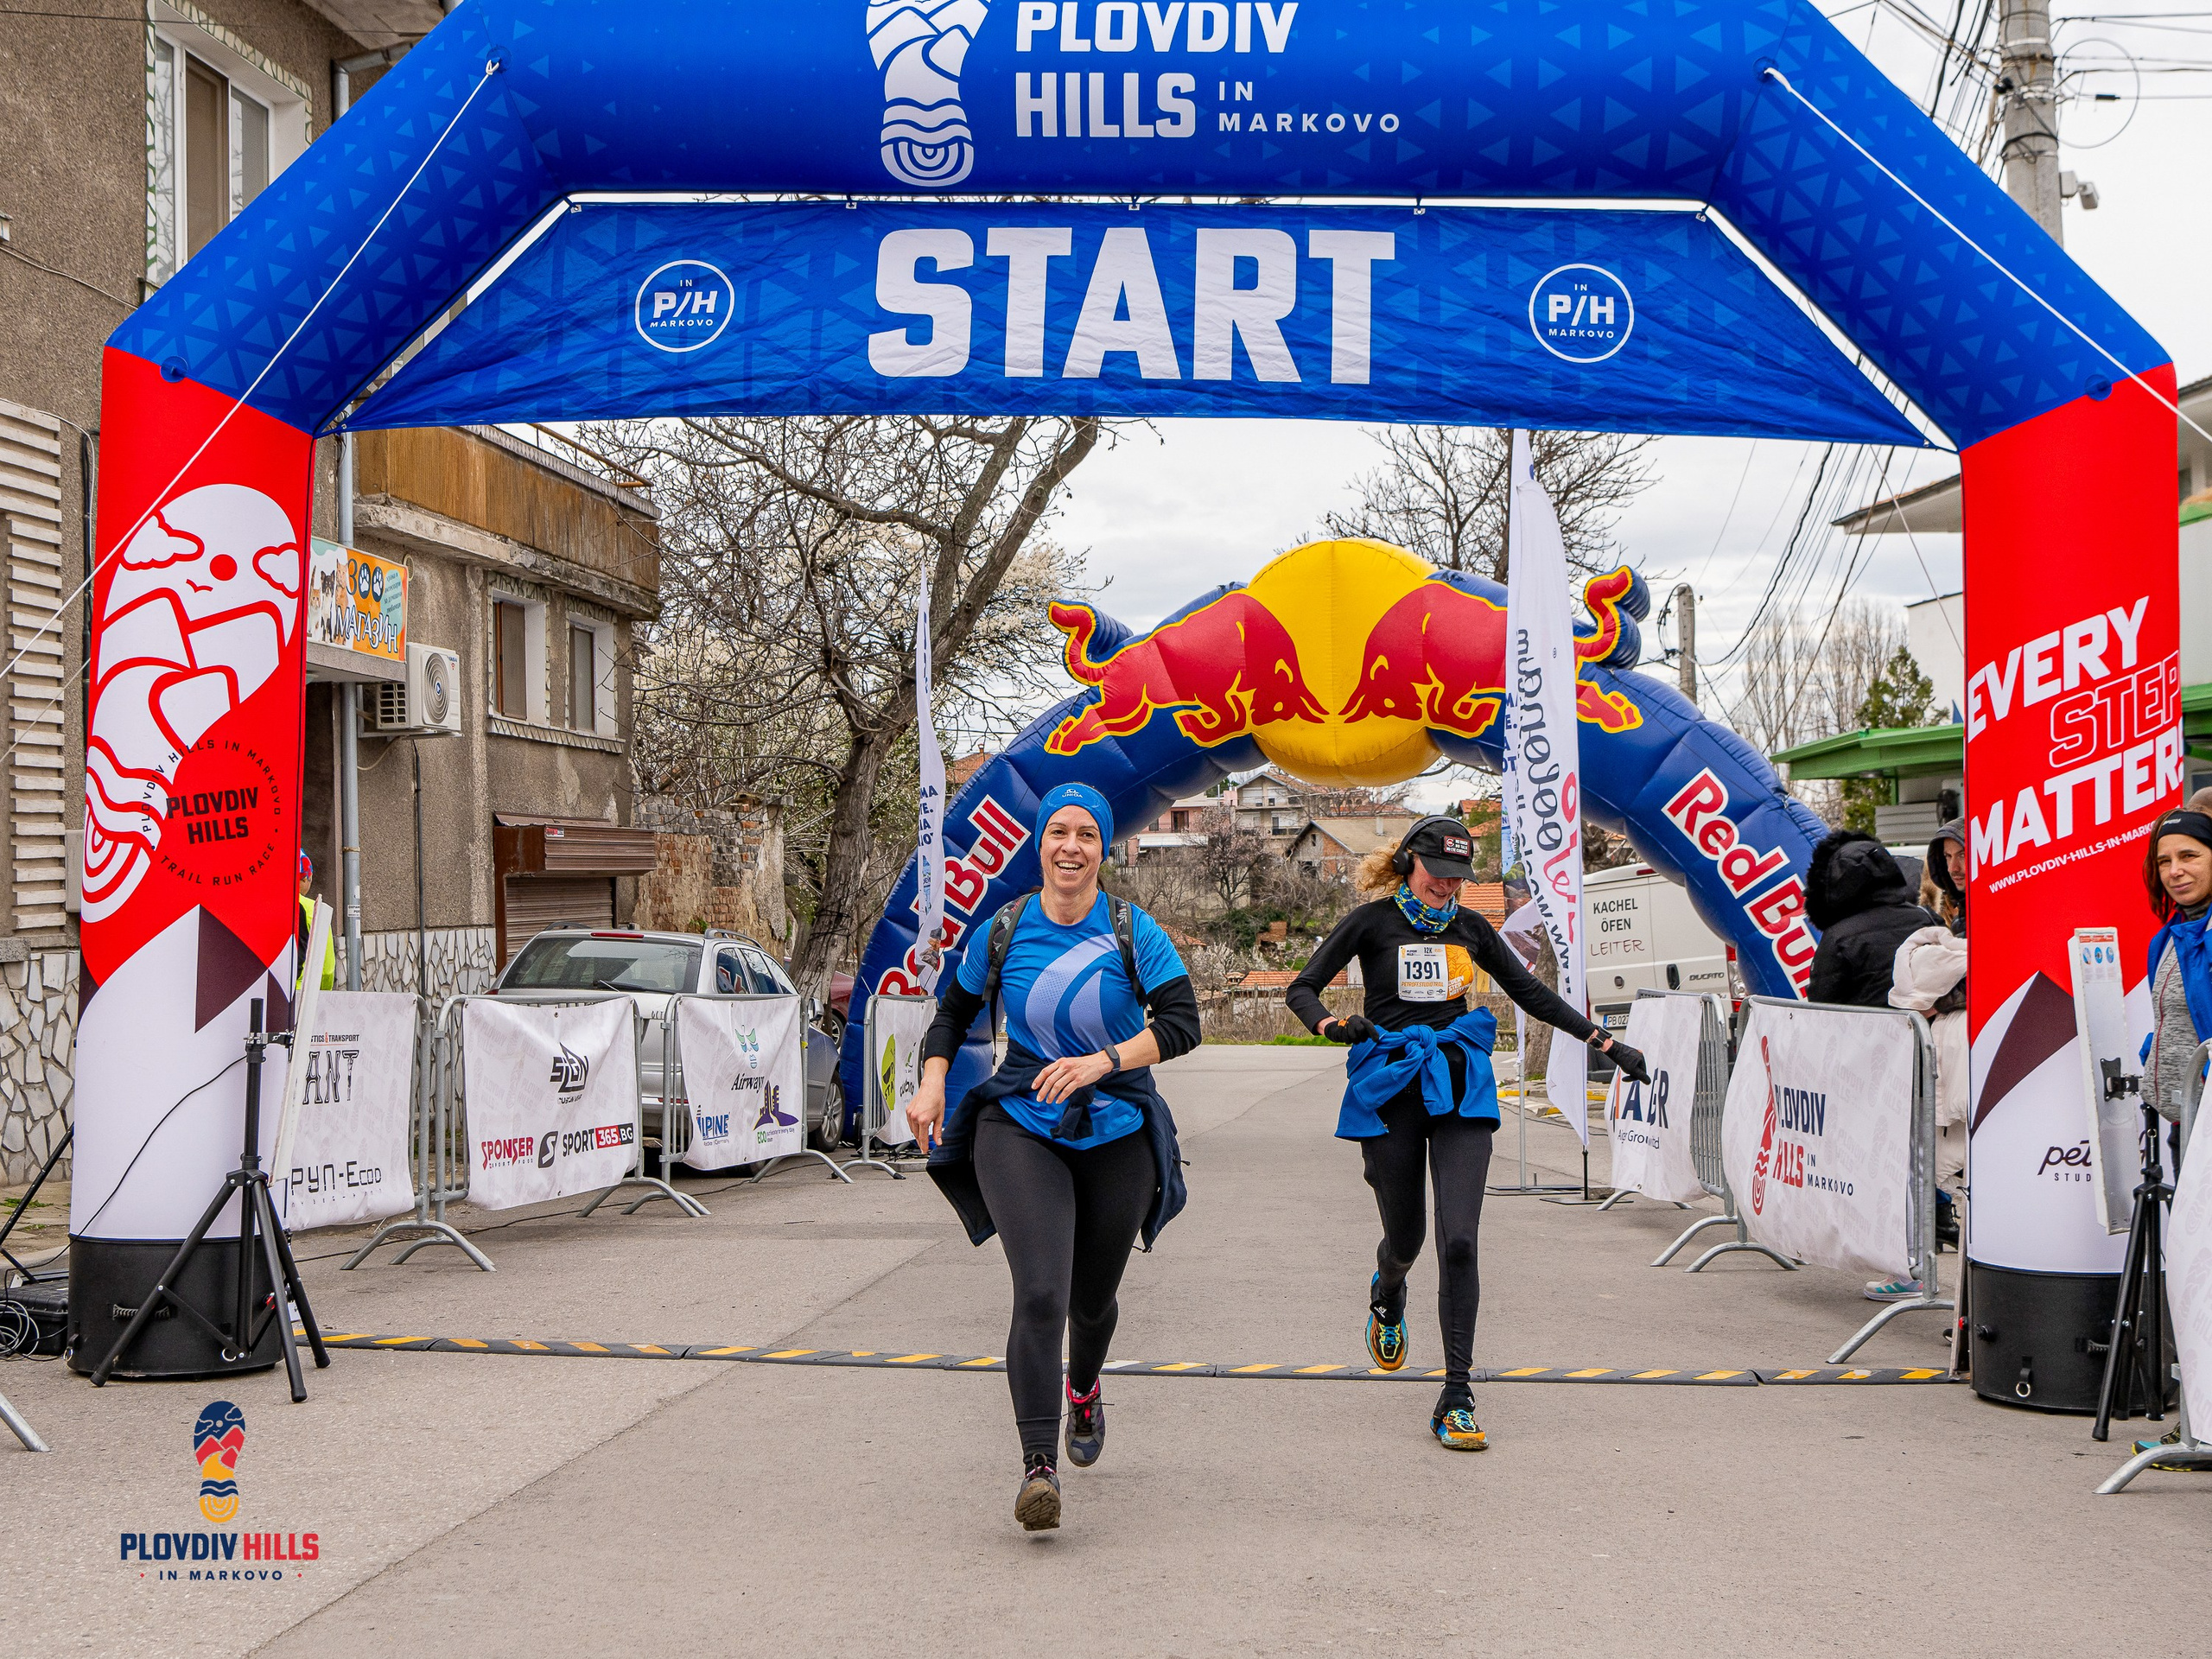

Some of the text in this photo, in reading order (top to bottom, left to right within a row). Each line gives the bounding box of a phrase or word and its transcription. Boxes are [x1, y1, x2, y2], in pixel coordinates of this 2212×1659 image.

[1015, 1, 1299, 53] PLOVDIV
[1218, 81, 1255, 101] IN
[1015, 73, 1197, 139] HILLS
[1218, 113, 1402, 133] MARKOVO
[652, 290, 718, 319] P/H
[867, 226, 1395, 385] START
[1548, 294, 1615, 327] P/H
[650, 319, 714, 328] MARKOVO
[1548, 328, 1614, 339] MARKOVO
[336, 605, 398, 653] МАГАЗИН
[1967, 595, 2150, 743] EVERY
[2049, 650, 2180, 768] STEP
[142, 740, 281, 833] PLOVDIV HILLS IN MARKOVO
[166, 786, 258, 819] PLOVDIV
[187, 817, 249, 845] HILLS
[1664, 771, 1787, 893] Red
[160, 842, 275, 887] TRAIL RUN RACE
[944, 797, 1029, 914] Bull
[1592, 898, 1638, 914] KACHEL
[1601, 918, 1631, 932] ÖFEN
[1590, 939, 1644, 957] LEITER
[1404, 961, 1440, 980] 1391
[757, 1130, 767, 1145] ECO
[481, 1136, 534, 1170] SPONSER
[1807, 1153, 1816, 1167] IN
[1807, 1173, 1854, 1196] MARKOVO
[2054, 1173, 2092, 1183] STUD
